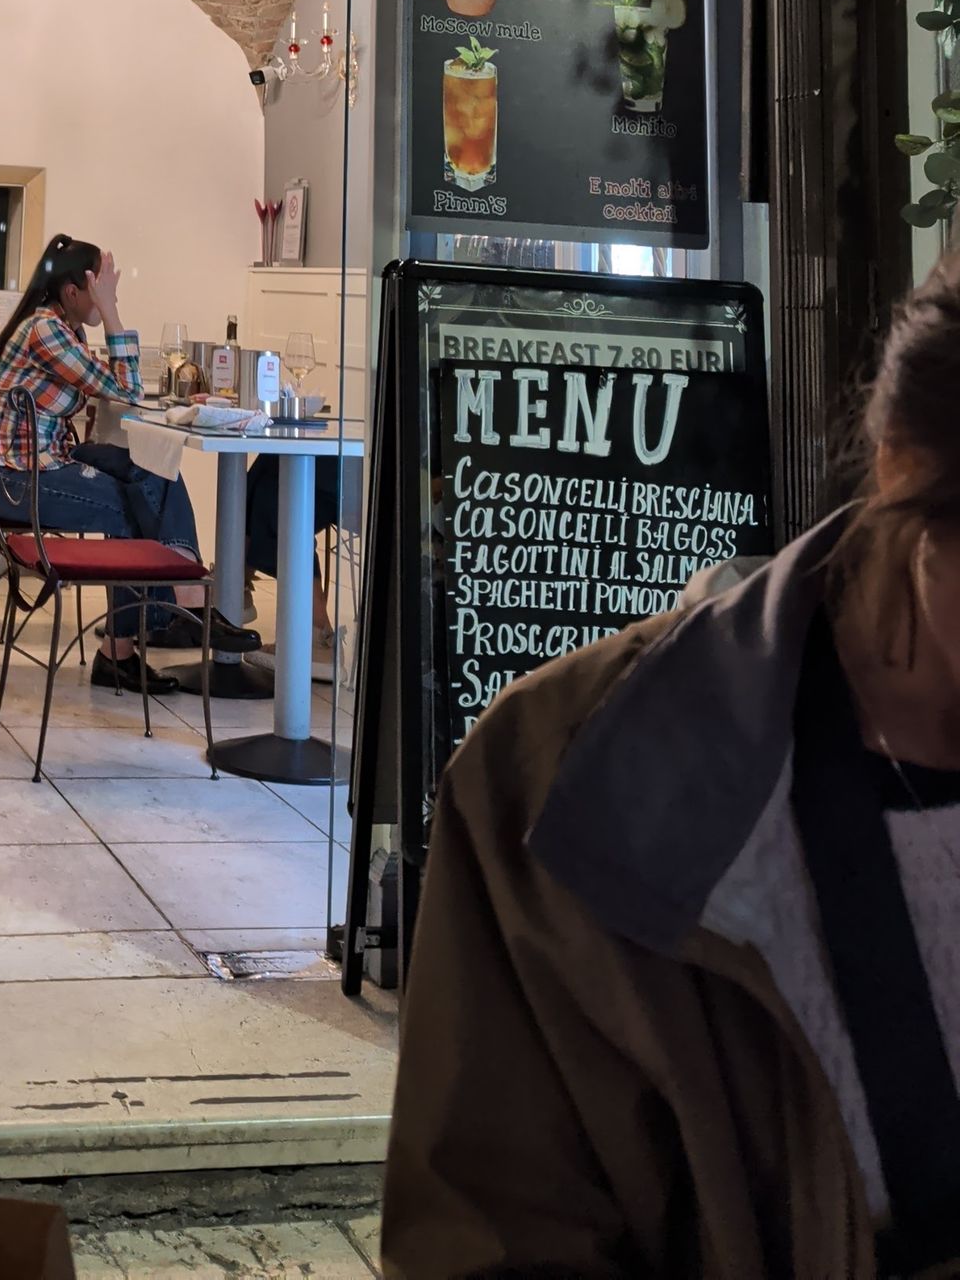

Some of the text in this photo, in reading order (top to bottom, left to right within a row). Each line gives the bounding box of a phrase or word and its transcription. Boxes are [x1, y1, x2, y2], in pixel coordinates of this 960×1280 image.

[496, 22, 542, 41] mule
[611, 116, 678, 138] Mohito
[589, 176, 601, 194] E
[605, 178, 652, 198] molti
[434, 191, 507, 216] Pimm's
[443, 335, 601, 368] BREAKFAST
[670, 349, 722, 372] EUR
[453, 368, 690, 466] MENU
[631, 483, 758, 526] BRESCIANA
[636, 519, 737, 560] BAGOSS
[607, 551, 631, 580] AL
[593, 582, 683, 616] POMODO
